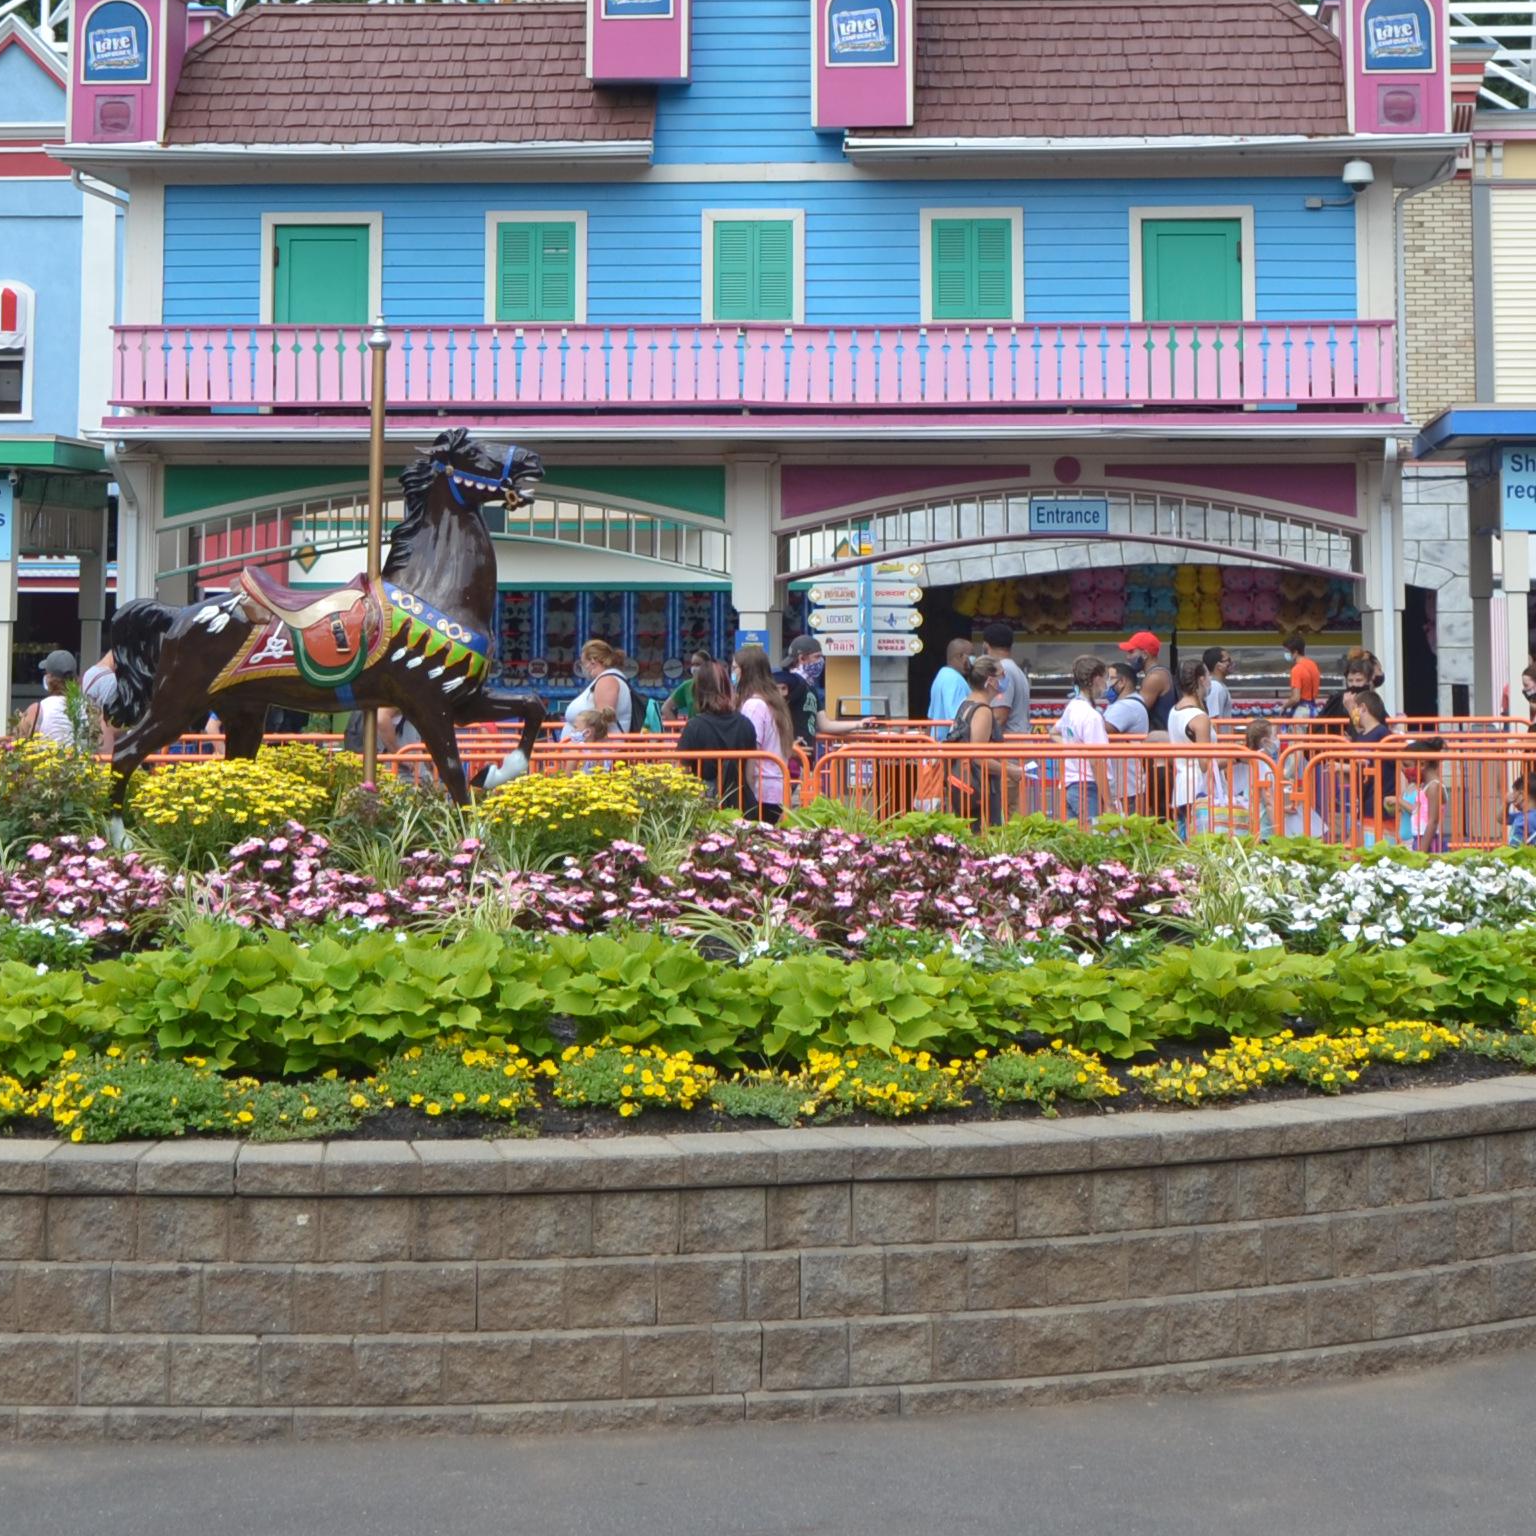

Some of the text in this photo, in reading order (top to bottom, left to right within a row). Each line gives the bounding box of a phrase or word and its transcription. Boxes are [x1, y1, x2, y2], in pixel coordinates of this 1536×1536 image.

[1036, 506, 1100, 524] Entrance
[826, 614, 853, 624] LOCKERS
[827, 642, 855, 651] TRAIN
